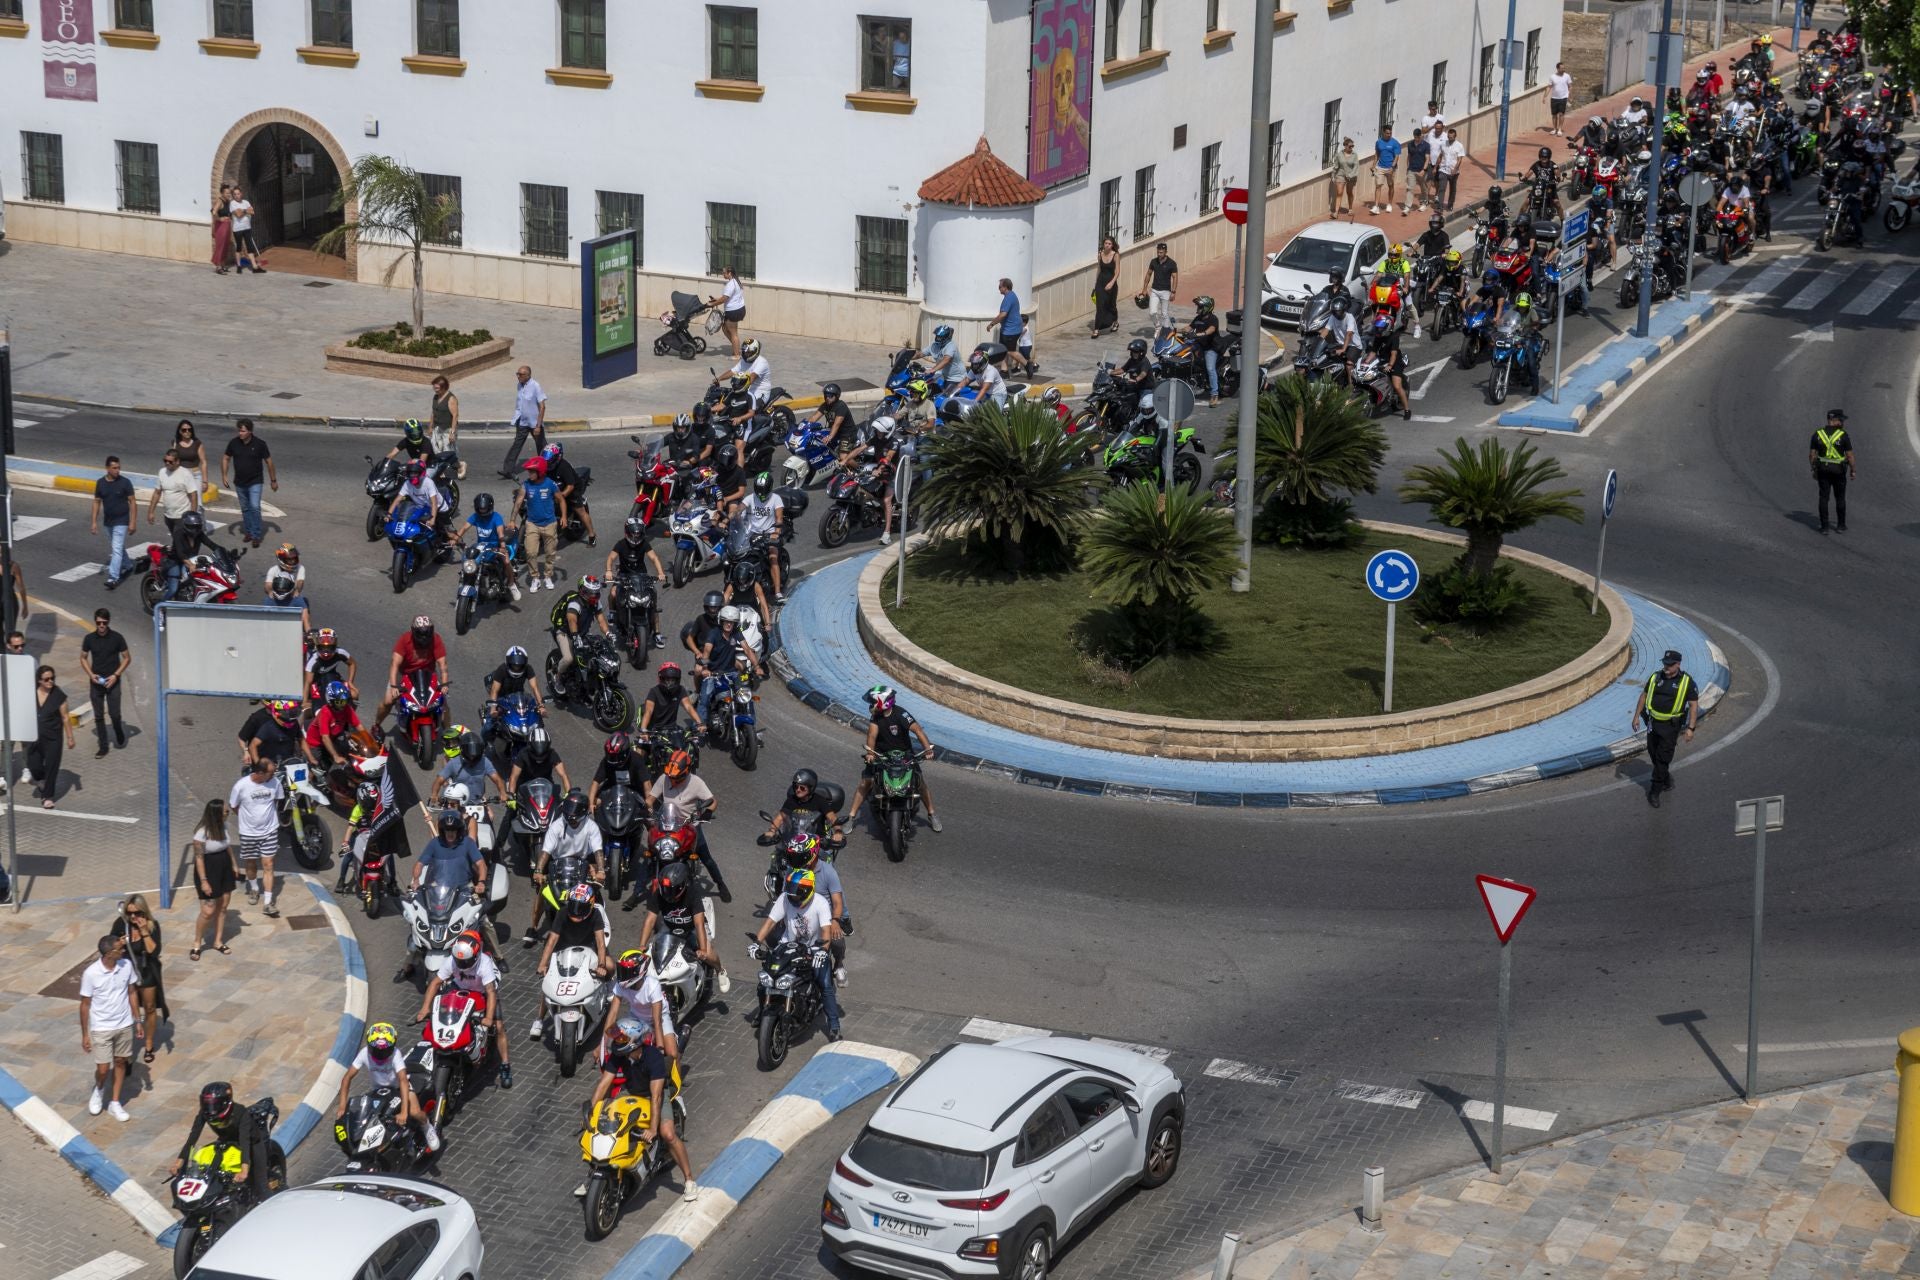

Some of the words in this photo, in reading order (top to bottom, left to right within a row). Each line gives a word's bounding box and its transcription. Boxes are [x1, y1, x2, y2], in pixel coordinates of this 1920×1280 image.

[556, 981, 581, 997] 83
[437, 1028, 456, 1041] 14
[335, 1125, 348, 1142] 46
[178, 1181, 203, 1197] 21
[880, 1214, 907, 1232] 7477
